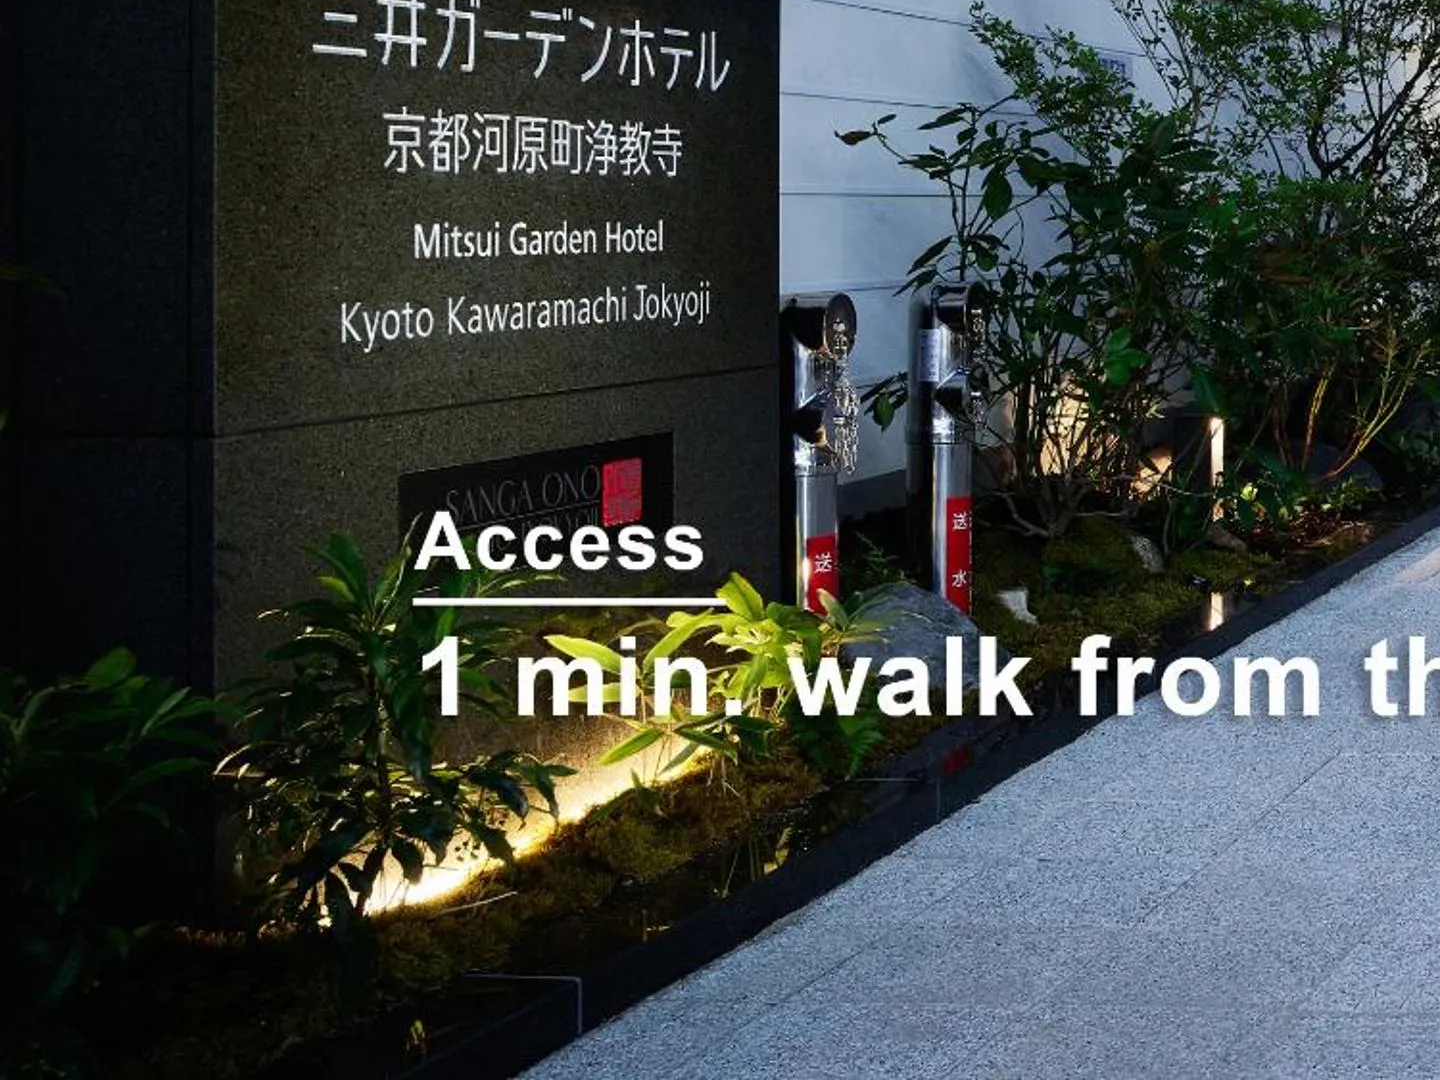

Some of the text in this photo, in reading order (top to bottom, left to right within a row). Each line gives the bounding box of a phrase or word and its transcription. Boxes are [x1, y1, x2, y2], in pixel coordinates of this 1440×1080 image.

[383, 106, 683, 177] 京都河原町浄教寺
[413, 220, 664, 260] Mitsui Garden Hotel
[341, 281, 710, 353] Kyoto Kawaramachi Jokyoji
[446, 479, 534, 525] SANGA
[542, 462, 601, 507] ONO
